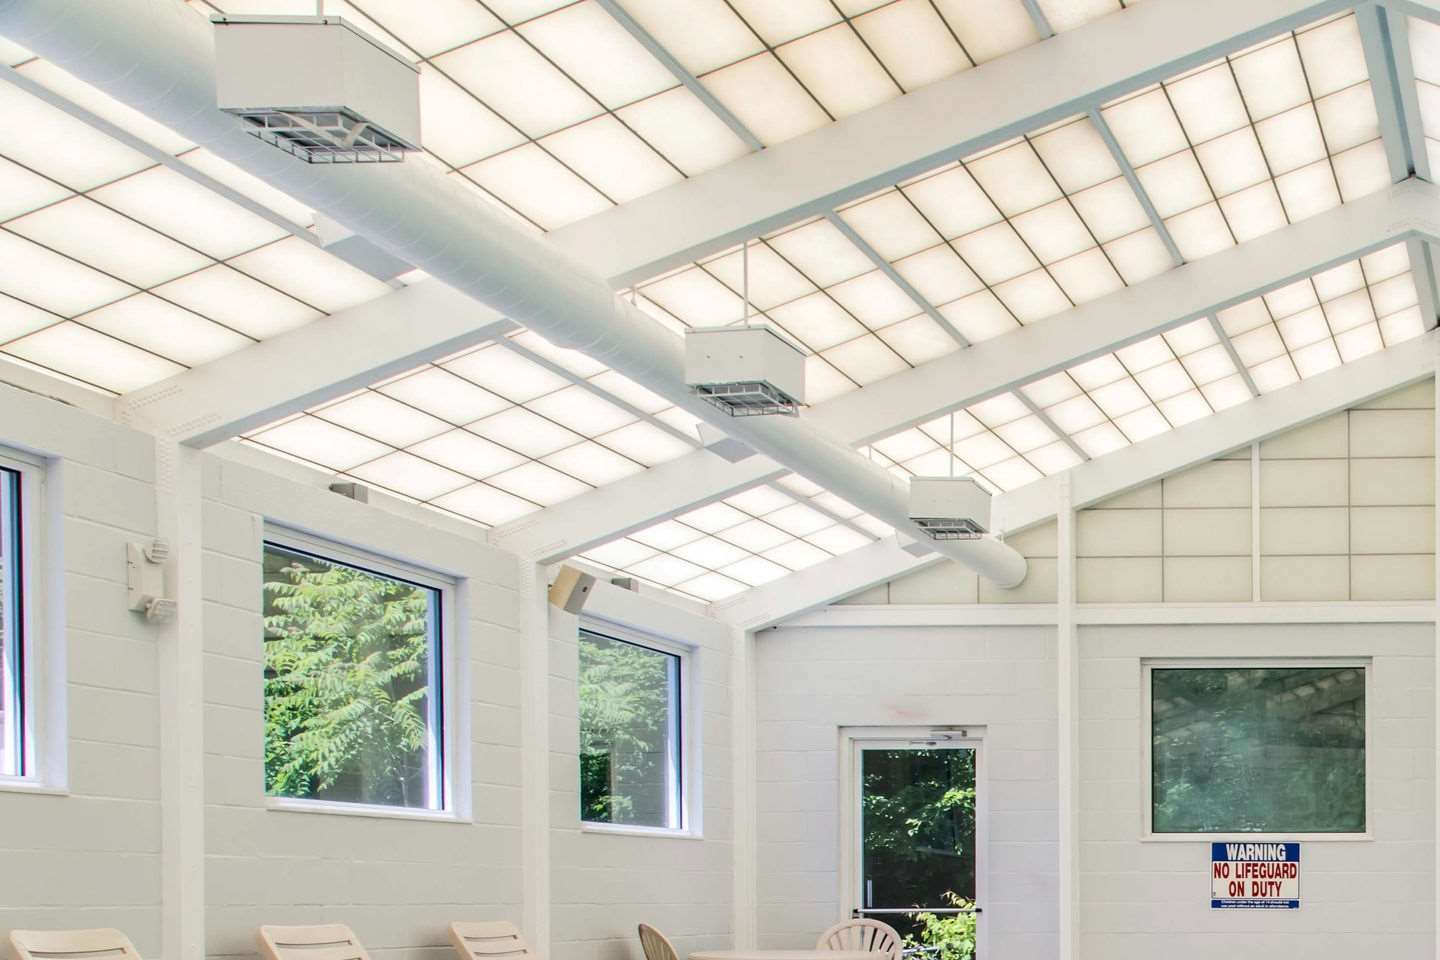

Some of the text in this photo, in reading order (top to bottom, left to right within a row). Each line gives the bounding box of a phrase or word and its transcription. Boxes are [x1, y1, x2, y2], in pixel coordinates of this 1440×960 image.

[1226, 844, 1286, 860] WARNING
[1214, 863, 1297, 878] NO LIFEGUARD
[1229, 881, 1281, 897] ON DUTY
